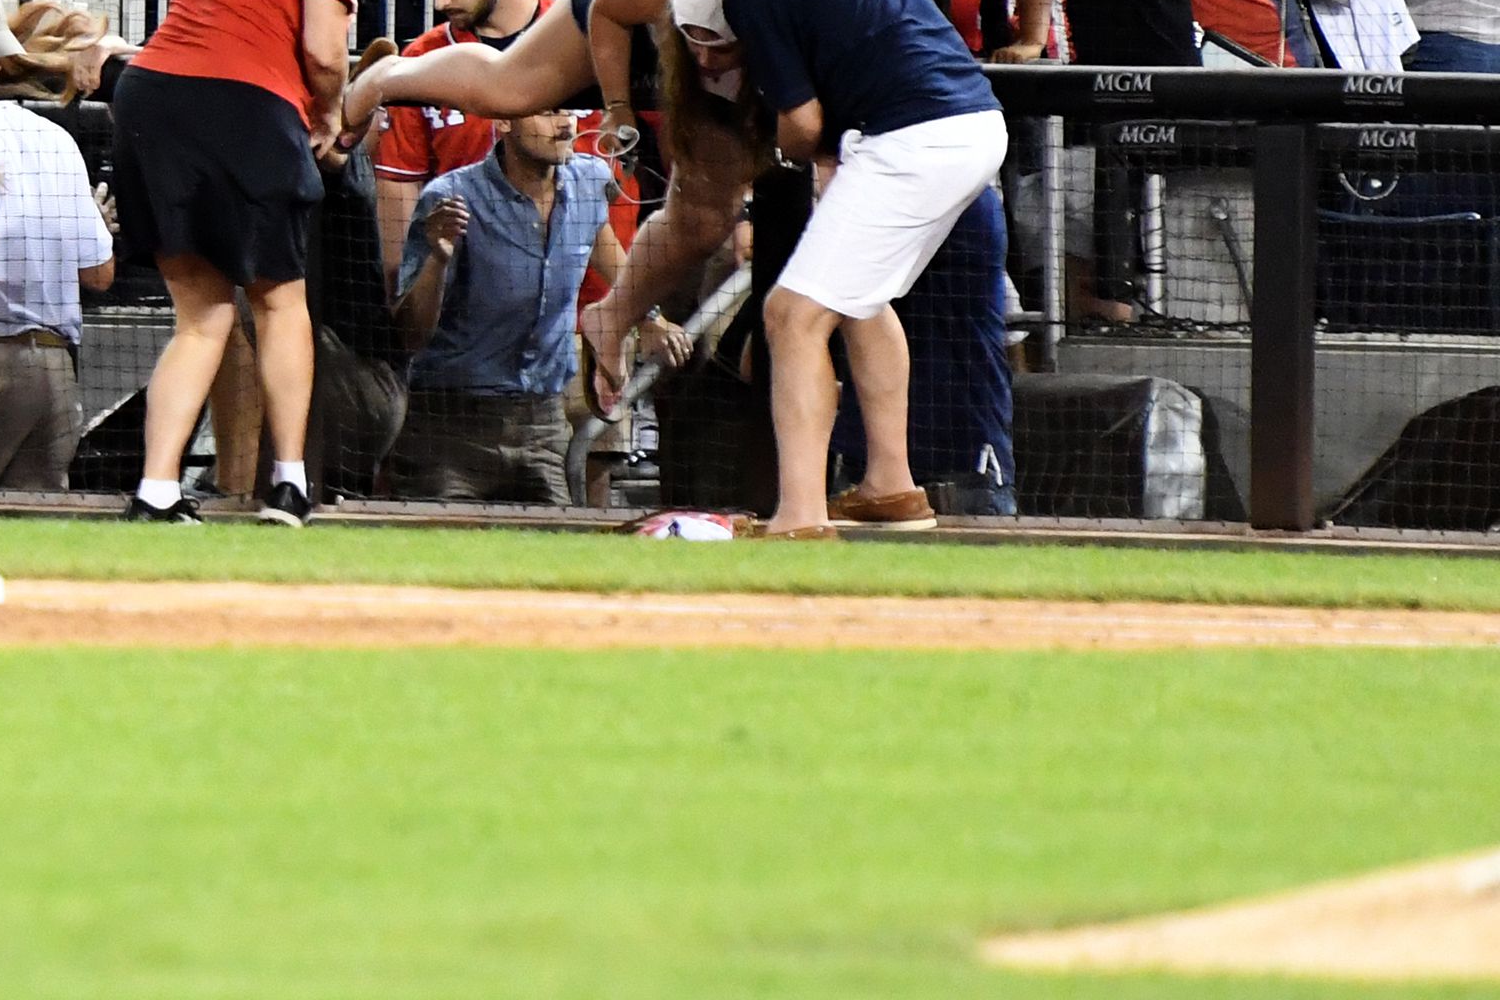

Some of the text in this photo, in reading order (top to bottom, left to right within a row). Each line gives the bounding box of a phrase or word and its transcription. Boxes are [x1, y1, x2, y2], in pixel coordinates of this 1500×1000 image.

[1093, 73, 1152, 92] MGM
[1343, 75, 1404, 95] MGM
[1119, 125, 1177, 144] MGM
[1359, 129, 1417, 148] MGM
